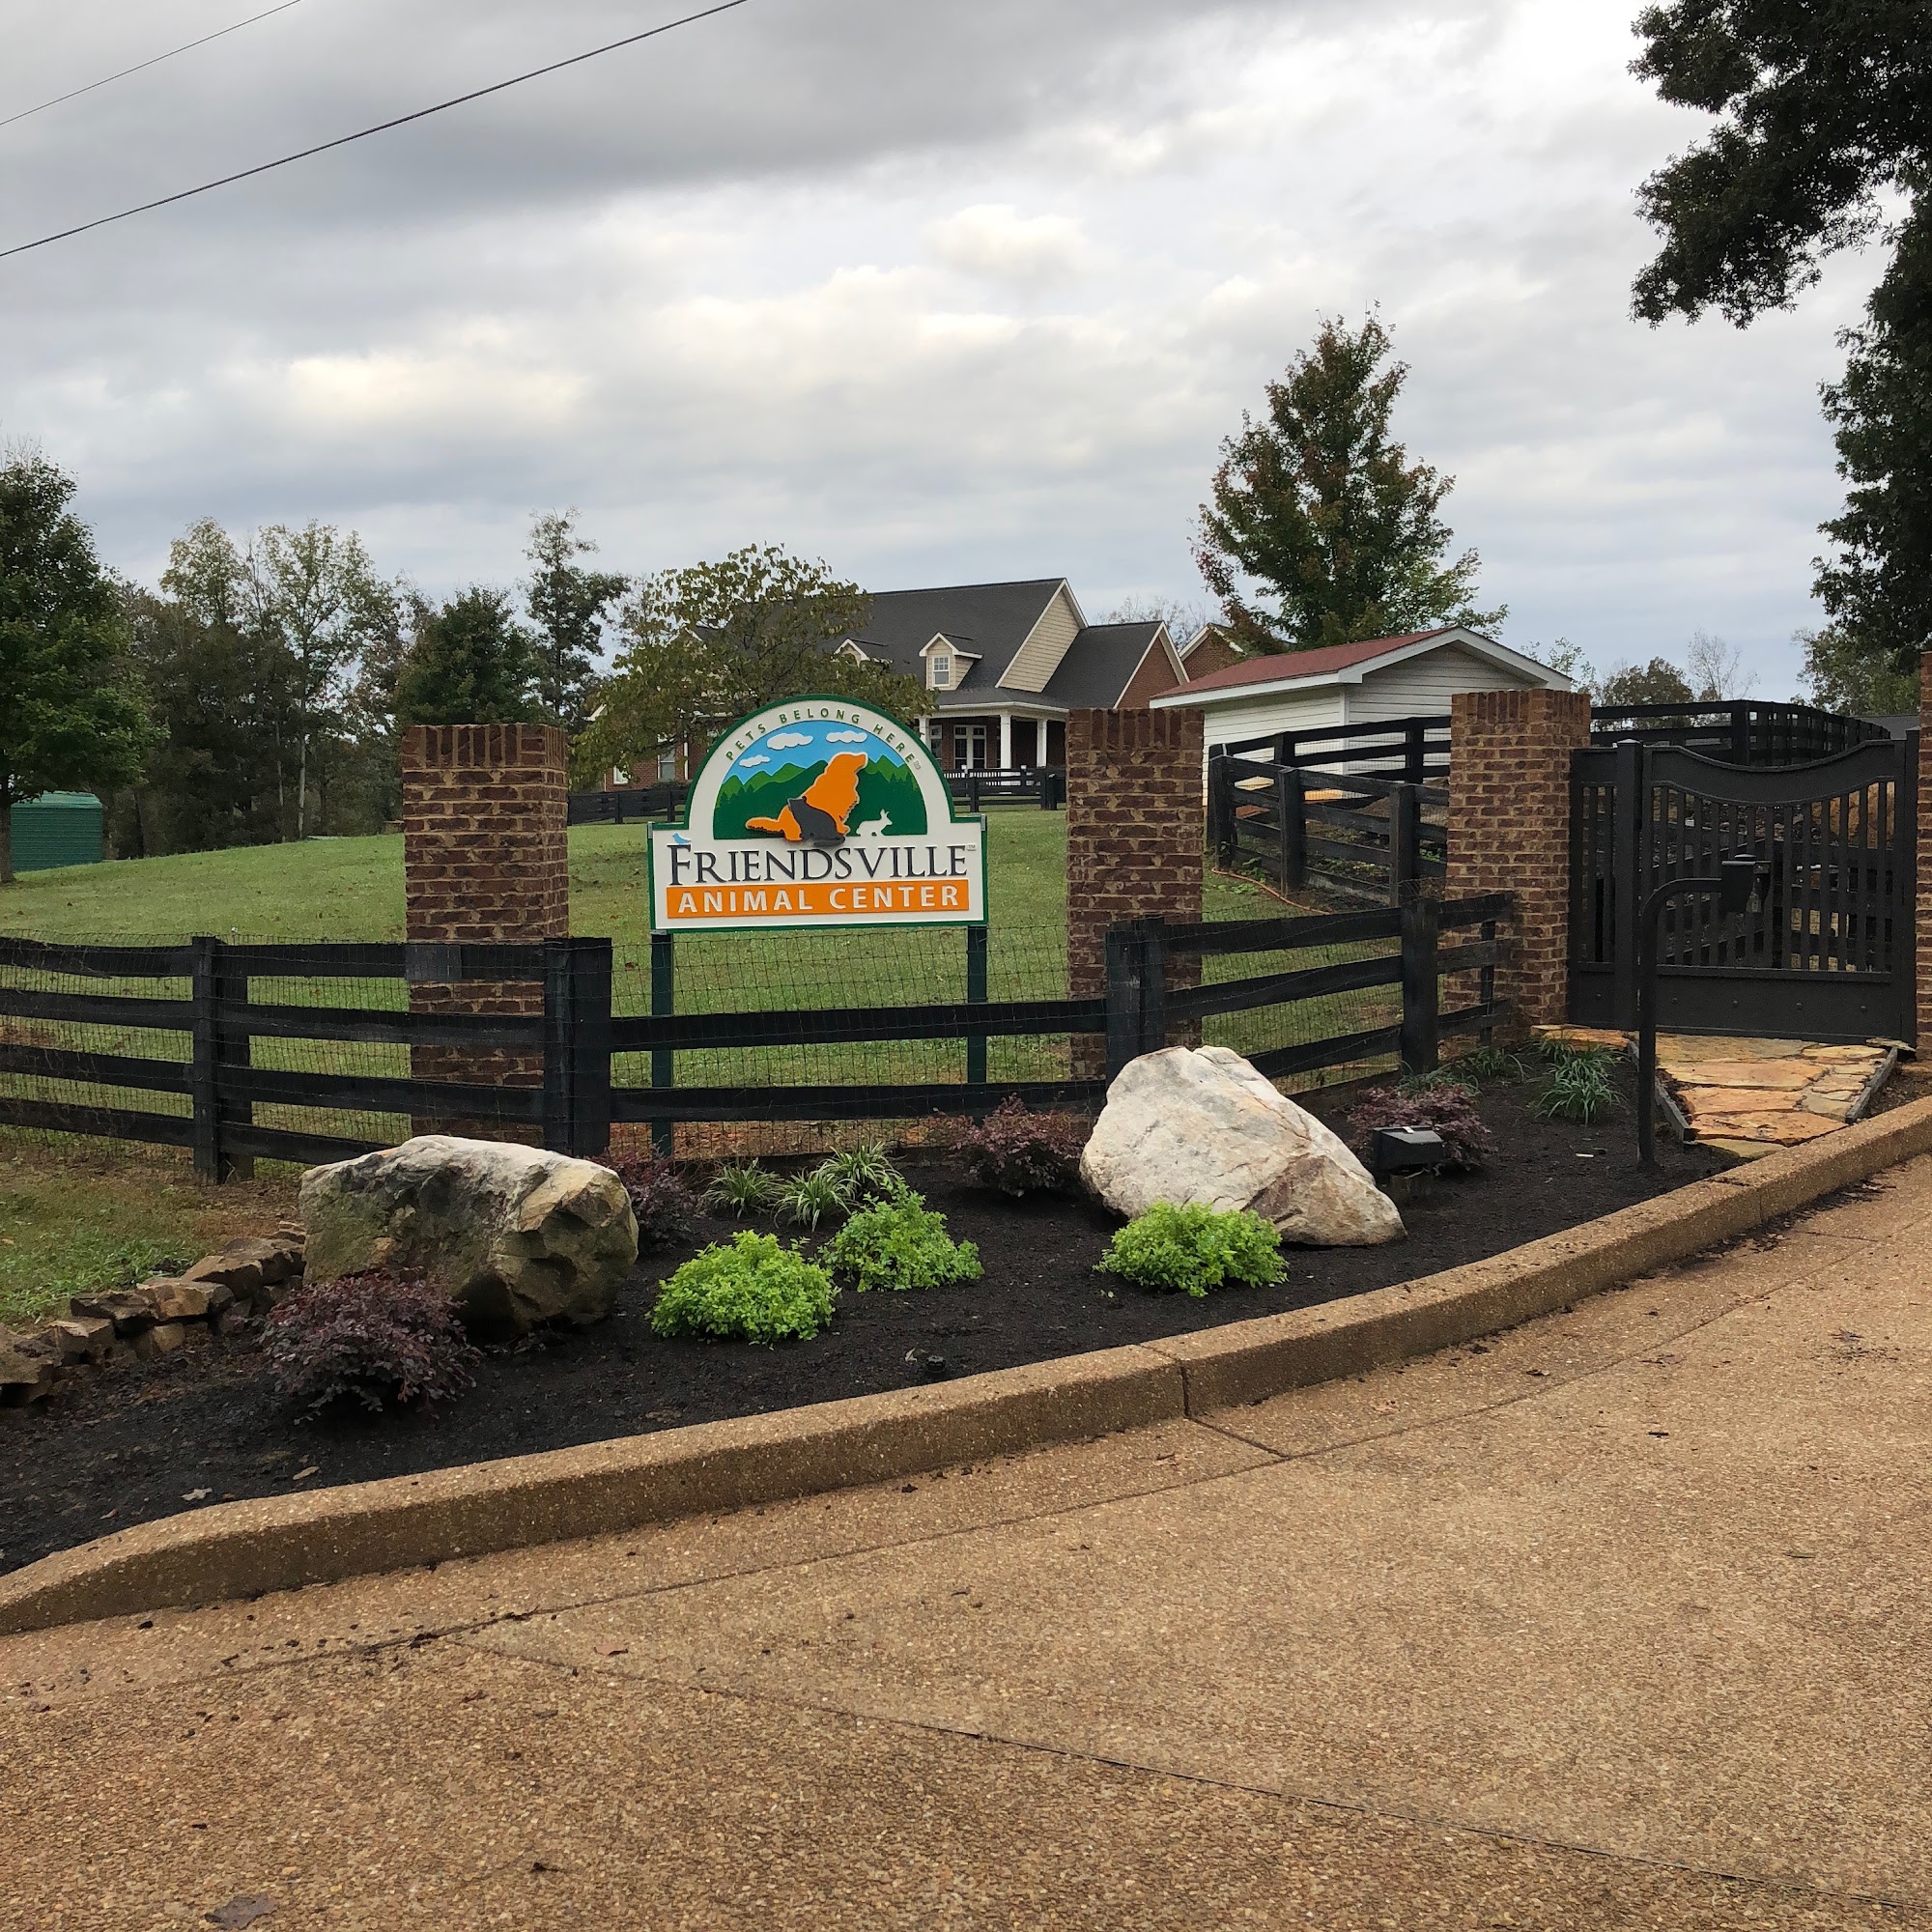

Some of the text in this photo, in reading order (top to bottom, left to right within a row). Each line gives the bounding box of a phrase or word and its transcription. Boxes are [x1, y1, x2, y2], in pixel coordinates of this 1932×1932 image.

[724, 708, 915, 763] PETS BELONG HERE
[667, 844, 967, 886] FRIENDSVILLE
[677, 885, 958, 914] ANIMAL CENTER
